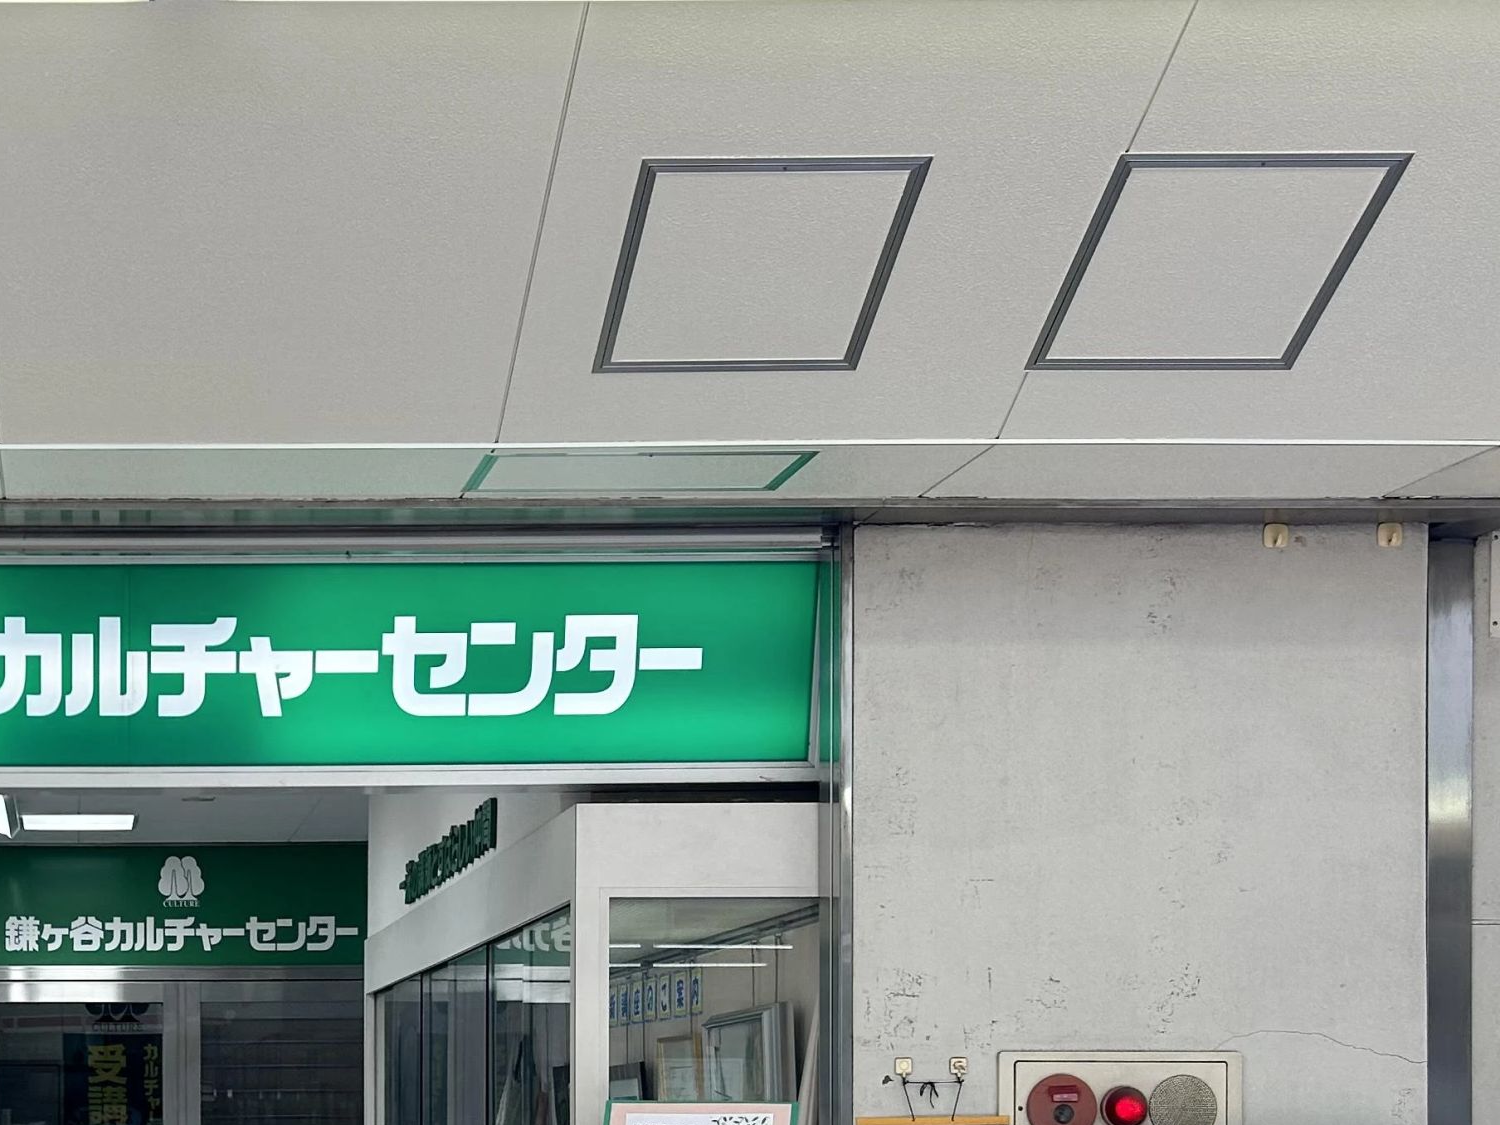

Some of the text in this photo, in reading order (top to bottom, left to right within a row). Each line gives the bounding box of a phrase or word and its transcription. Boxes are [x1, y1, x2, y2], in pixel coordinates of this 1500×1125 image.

[162, 900, 201, 908] CULTURE
[5, 916, 359, 952] 鎌ヶ谷カルチャーセンター
